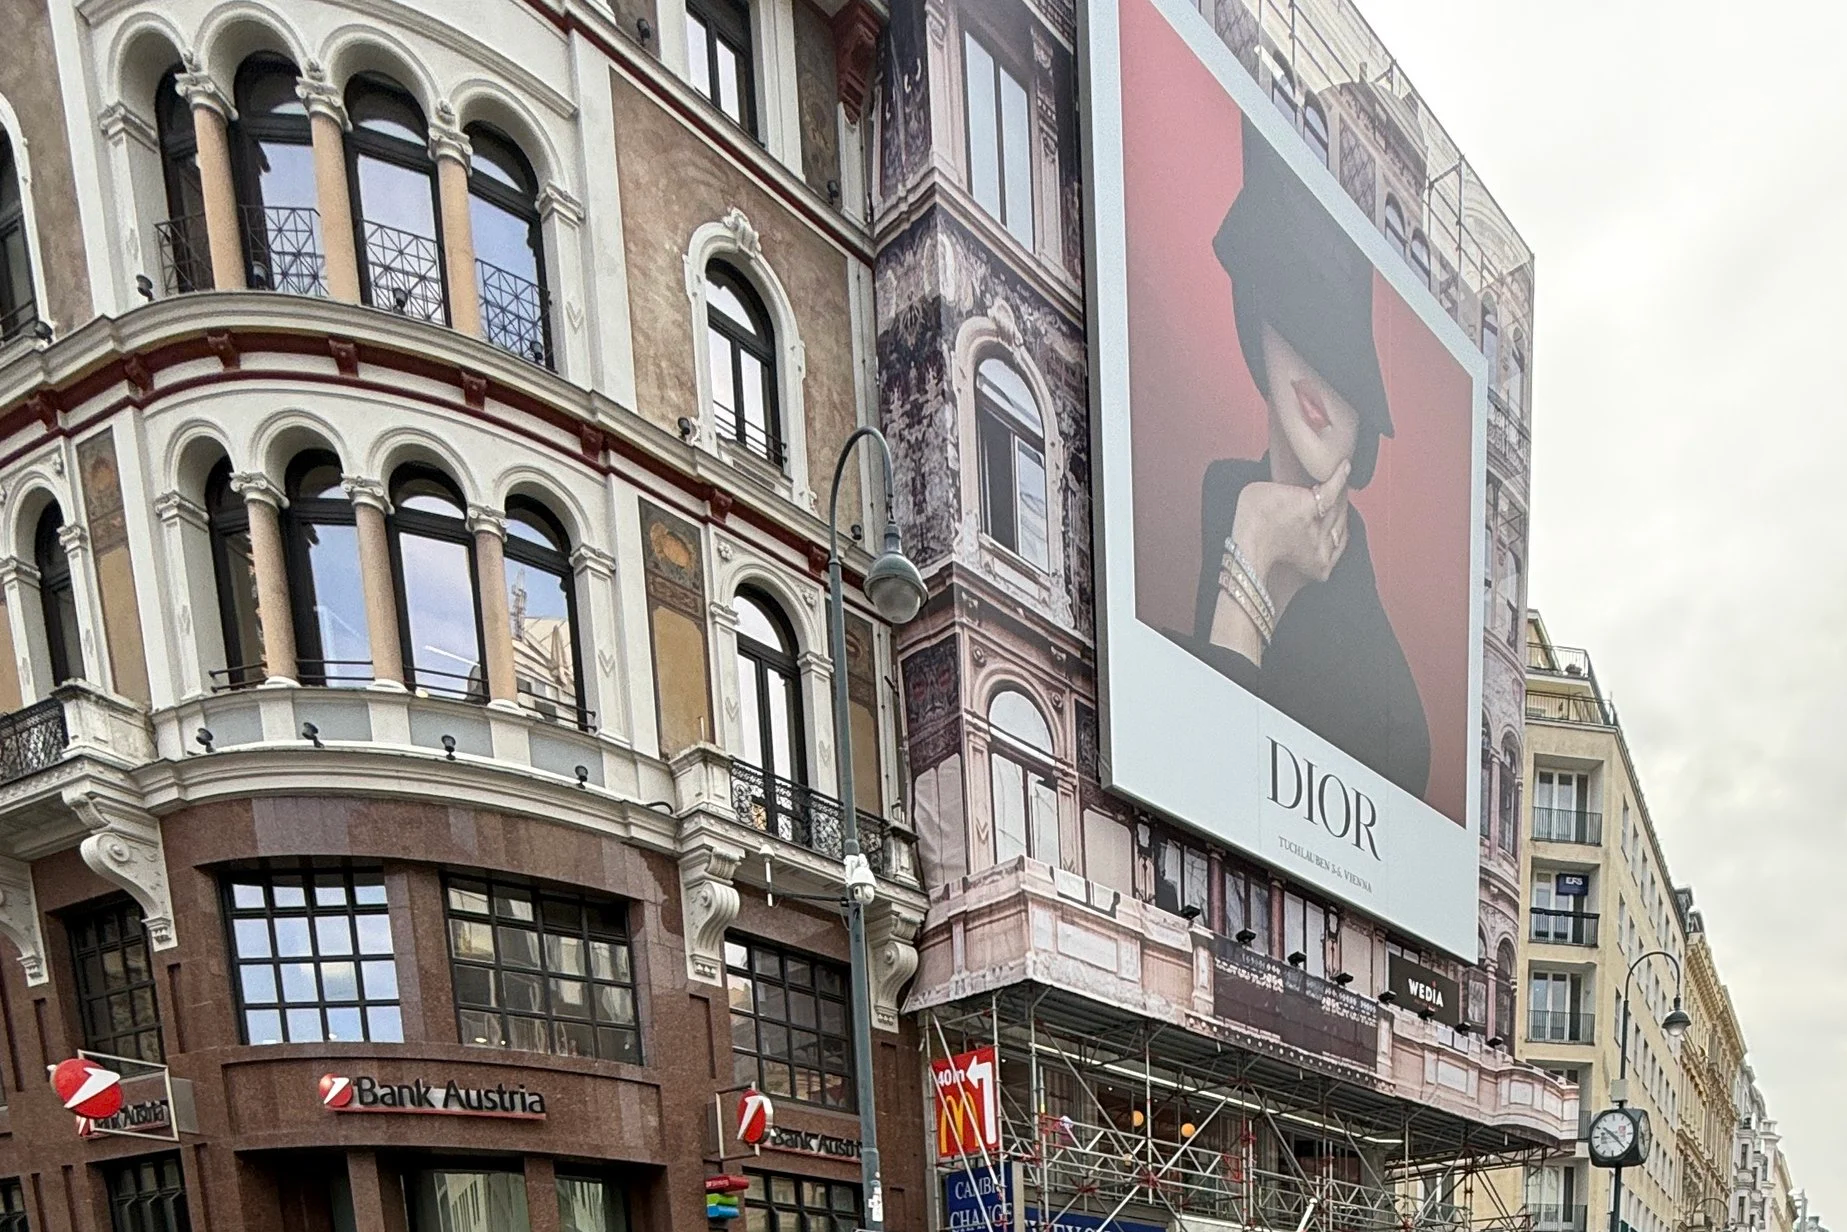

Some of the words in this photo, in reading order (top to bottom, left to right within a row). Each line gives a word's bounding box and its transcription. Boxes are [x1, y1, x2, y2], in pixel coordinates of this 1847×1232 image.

[1266, 736, 1381, 861] DIOR
[1344, 869, 1373, 893] VIENNA
[353, 1076, 436, 1108] Bank
[443, 1079, 546, 1114] Austria
[771, 1126, 815, 1151] Bank
